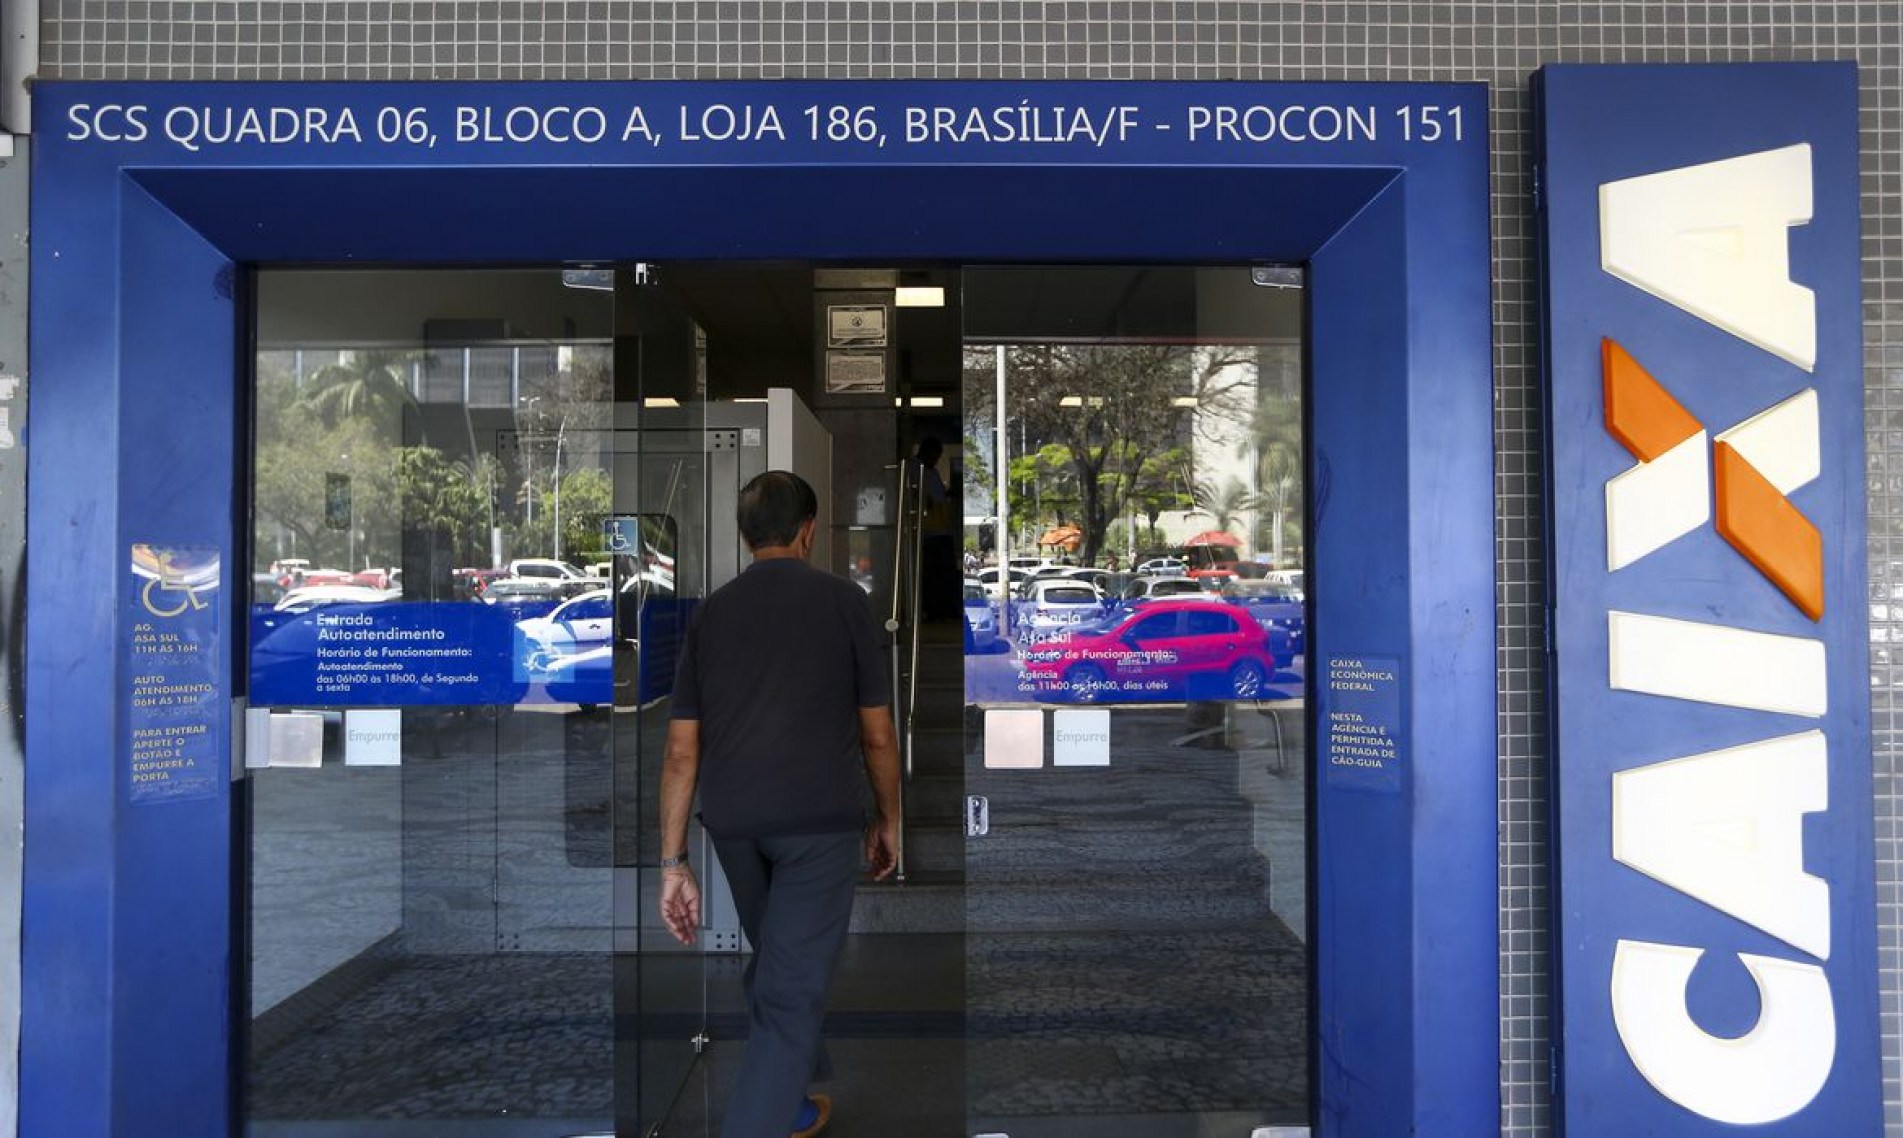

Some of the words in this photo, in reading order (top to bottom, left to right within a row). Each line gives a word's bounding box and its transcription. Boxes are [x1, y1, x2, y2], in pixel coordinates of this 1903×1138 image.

[66, 104, 148, 142] SCS
[163, 106, 362, 150] QUADRA
[376, 106, 438, 148] 06,
[455, 106, 607, 143] BLOCO
[621, 106, 662, 148] A,
[679, 105, 786, 142] LOJA
[803, 106, 887, 148] 186,
[905, 100, 1139, 147] BRASÍLIA/F
[1187, 106, 1377, 142] PROCON
[1396, 106, 1464, 142] 151
[316, 613, 373, 625] Entrada
[1018, 611, 1081, 627] Agncia
[134, 634, 157, 643] ASA
[160, 633, 180, 642] SUL
[318, 627, 445, 640] Autoatendimento
[1050, 631, 1071, 644] Sul
[1599, 142, 1837, 1125] CAIXA
[135, 645, 157, 654] 11H
[178, 643, 198, 652] 16H
[316, 646, 361, 658] Horário
[364, 647, 378, 657] de
[382, 647, 472, 658] Funcionamento:
[1065, 649, 1079, 659] de
[318, 662, 403, 671] Autoatendimento
[1329, 659, 1362, 668] CAIXA
[134, 676, 165, 685] AUTO
[316, 674, 334, 684] das
[337, 674, 368, 684] 06h00
[421, 674, 434, 684] de
[436, 674, 478, 686] Segunda
[1018, 670, 1058, 681] Agência
[134, 684, 212, 694] ATENDIMENTO
[326, 683, 350, 692] sexta
[1018, 682, 1035, 692] das
[1039, 681, 1069, 691] 11h00
[1123, 680, 1143, 690] dias
[1146, 680, 1169, 690] úteis
[1330, 682, 1375, 692] FEDERAL
[1330, 712, 1363, 723] NESTA
[134, 729, 162, 738] PARA
[165, 725, 207, 736] ENTRAR
[349, 729, 399, 744] Empurre
[134, 739, 172, 749] APERTE
[177, 737, 185, 746] O
[1056, 729, 1107, 747] Empurre
[1330, 734, 1384, 746] PERMITIDA
[1385, 738, 1394, 747] A
[1330, 746, 1379, 757] ENTRADA
[1381, 749, 1396, 759] DE
[132, 760, 183, 771] EMPURRE
[186, 758, 195, 767] A
[132, 772, 169, 782] PORTA
